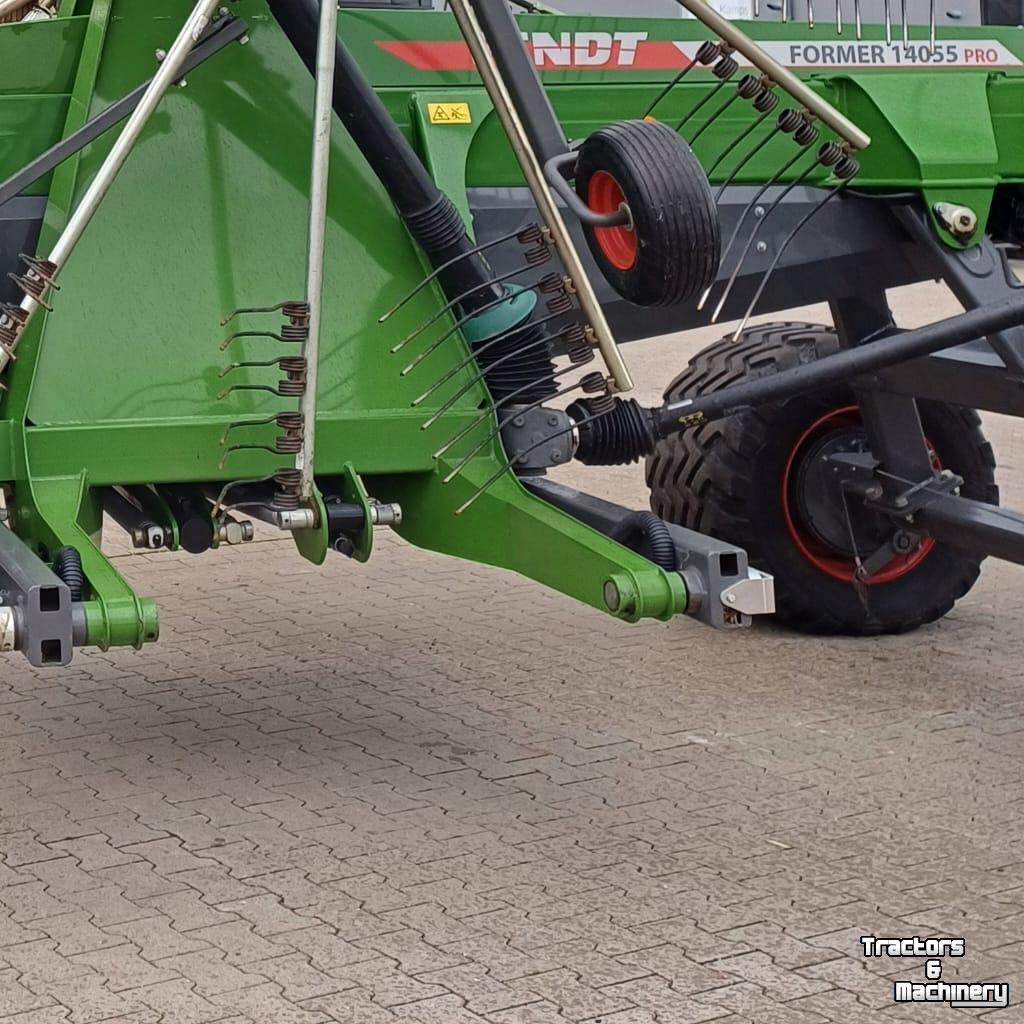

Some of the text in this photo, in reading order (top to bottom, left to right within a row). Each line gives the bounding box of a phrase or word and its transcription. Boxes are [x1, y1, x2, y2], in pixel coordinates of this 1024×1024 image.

[521, 31, 649, 66] NDT
[790, 44, 998, 64] FORMER 14055 PRO
